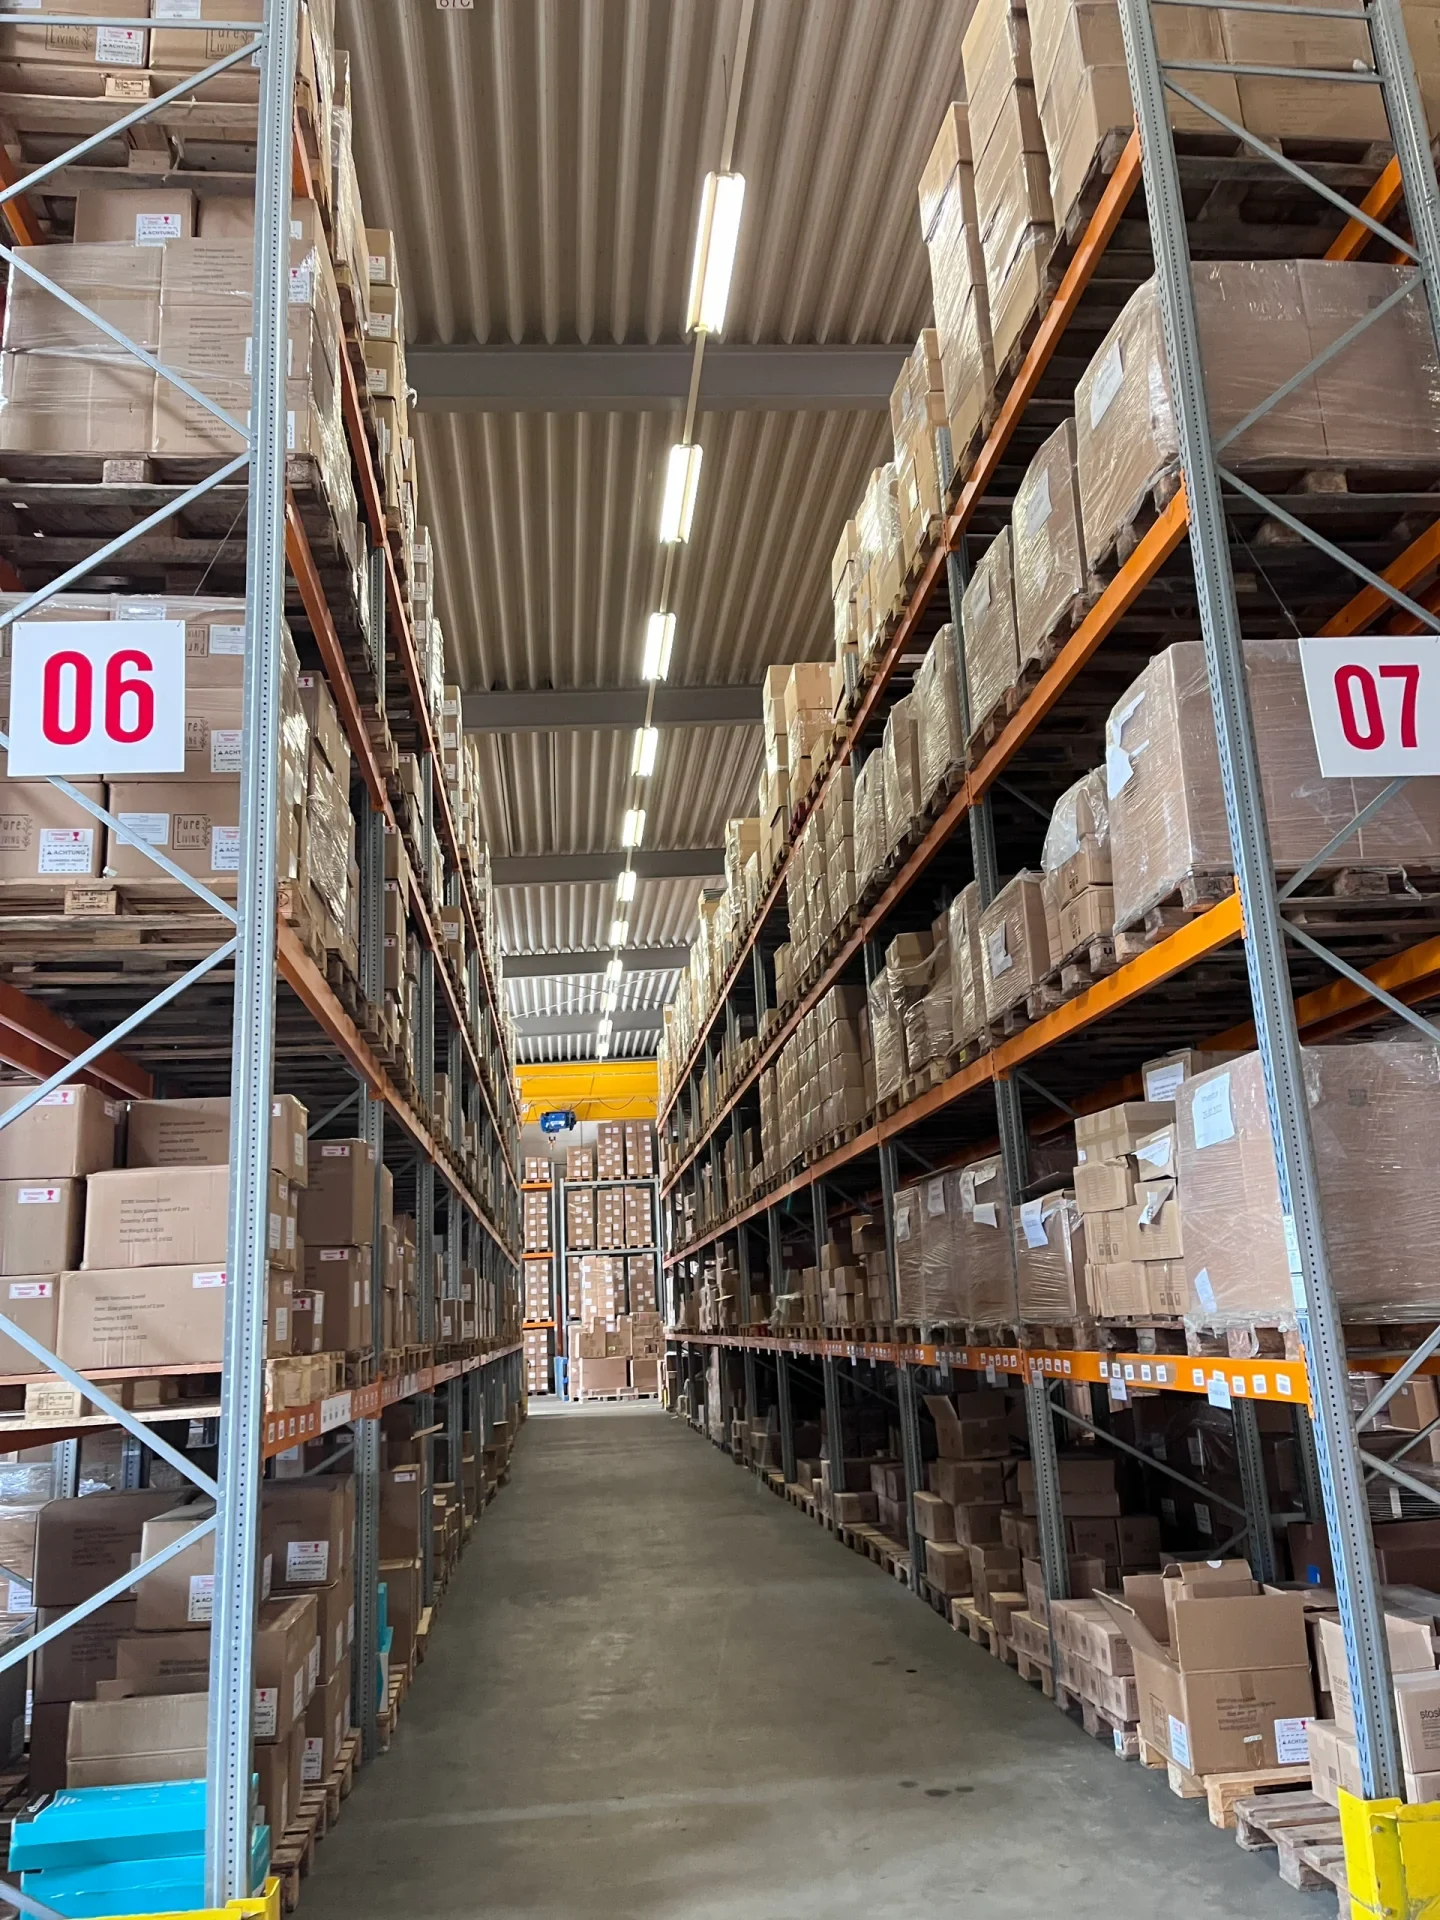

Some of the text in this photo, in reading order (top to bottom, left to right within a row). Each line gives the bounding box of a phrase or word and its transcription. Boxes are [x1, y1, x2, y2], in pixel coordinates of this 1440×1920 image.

[108, 43, 137, 51] ACHTUNG
[42, 649, 155, 746] 06
[1334, 665, 1420, 750] 07
[177, 816, 200, 830] Pure
